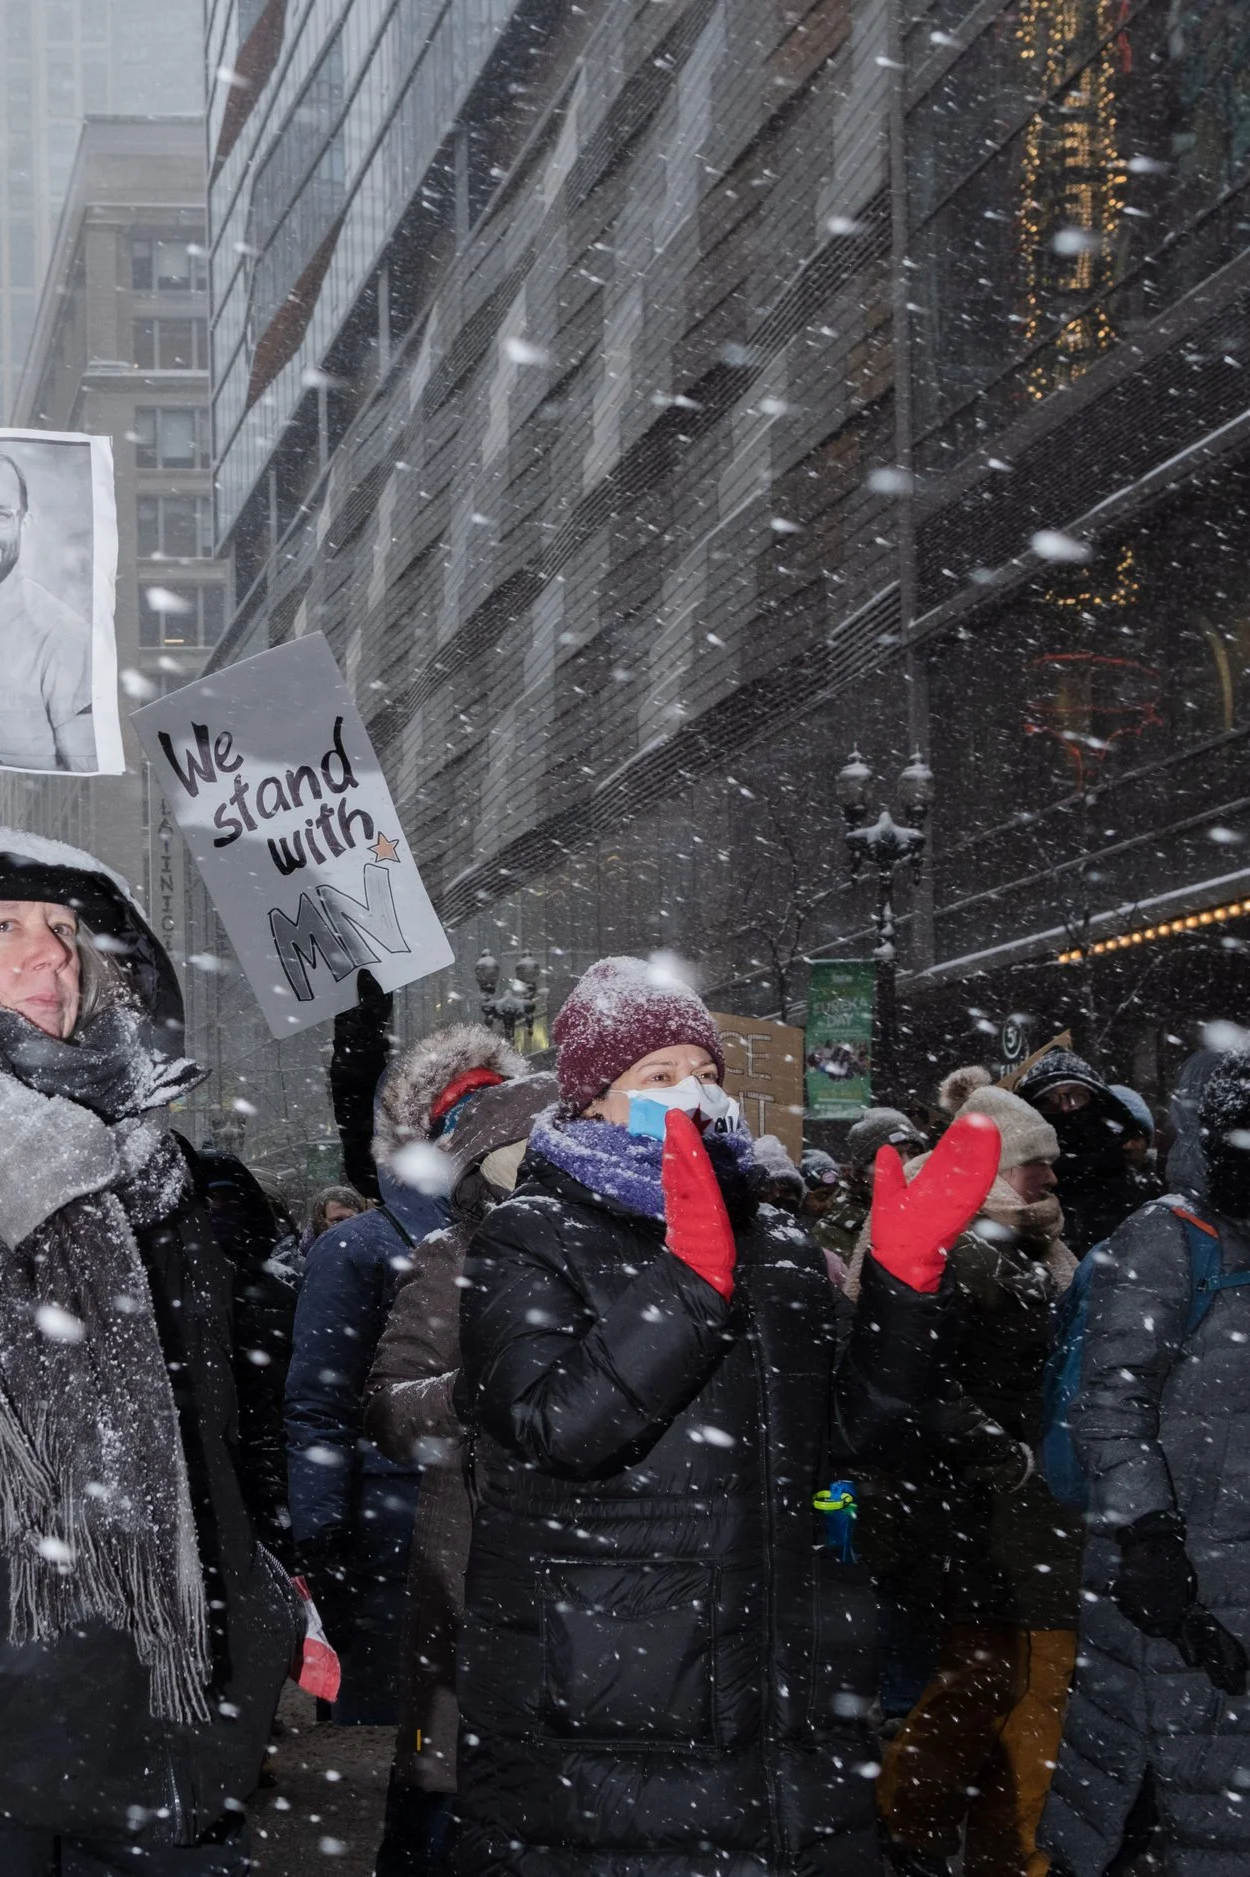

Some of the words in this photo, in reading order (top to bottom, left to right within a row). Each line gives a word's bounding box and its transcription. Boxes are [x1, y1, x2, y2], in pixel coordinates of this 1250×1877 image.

[158, 721, 244, 797] We
[213, 716, 359, 848] stand
[267, 797, 374, 875] with
[269, 863, 411, 1001] MN
